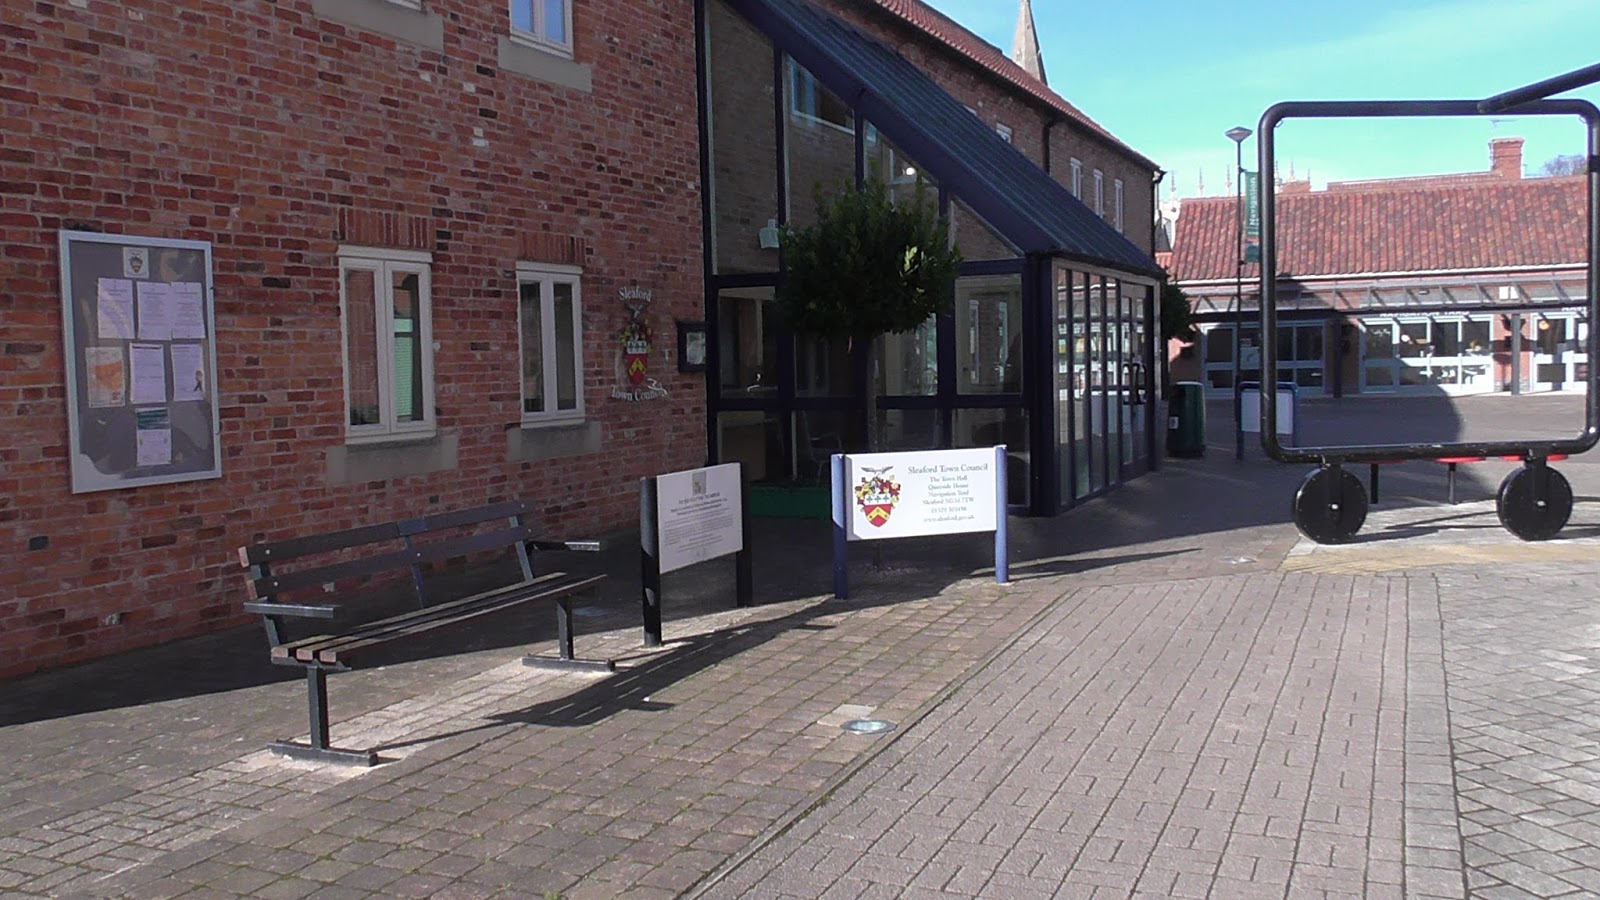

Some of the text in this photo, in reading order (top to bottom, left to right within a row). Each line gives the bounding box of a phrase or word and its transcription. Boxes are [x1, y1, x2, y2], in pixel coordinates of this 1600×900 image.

[618, 286, 652, 302] Sleaford
[611, 384, 633, 402] Town
[908, 463, 988, 474] Sleaford Town Council
